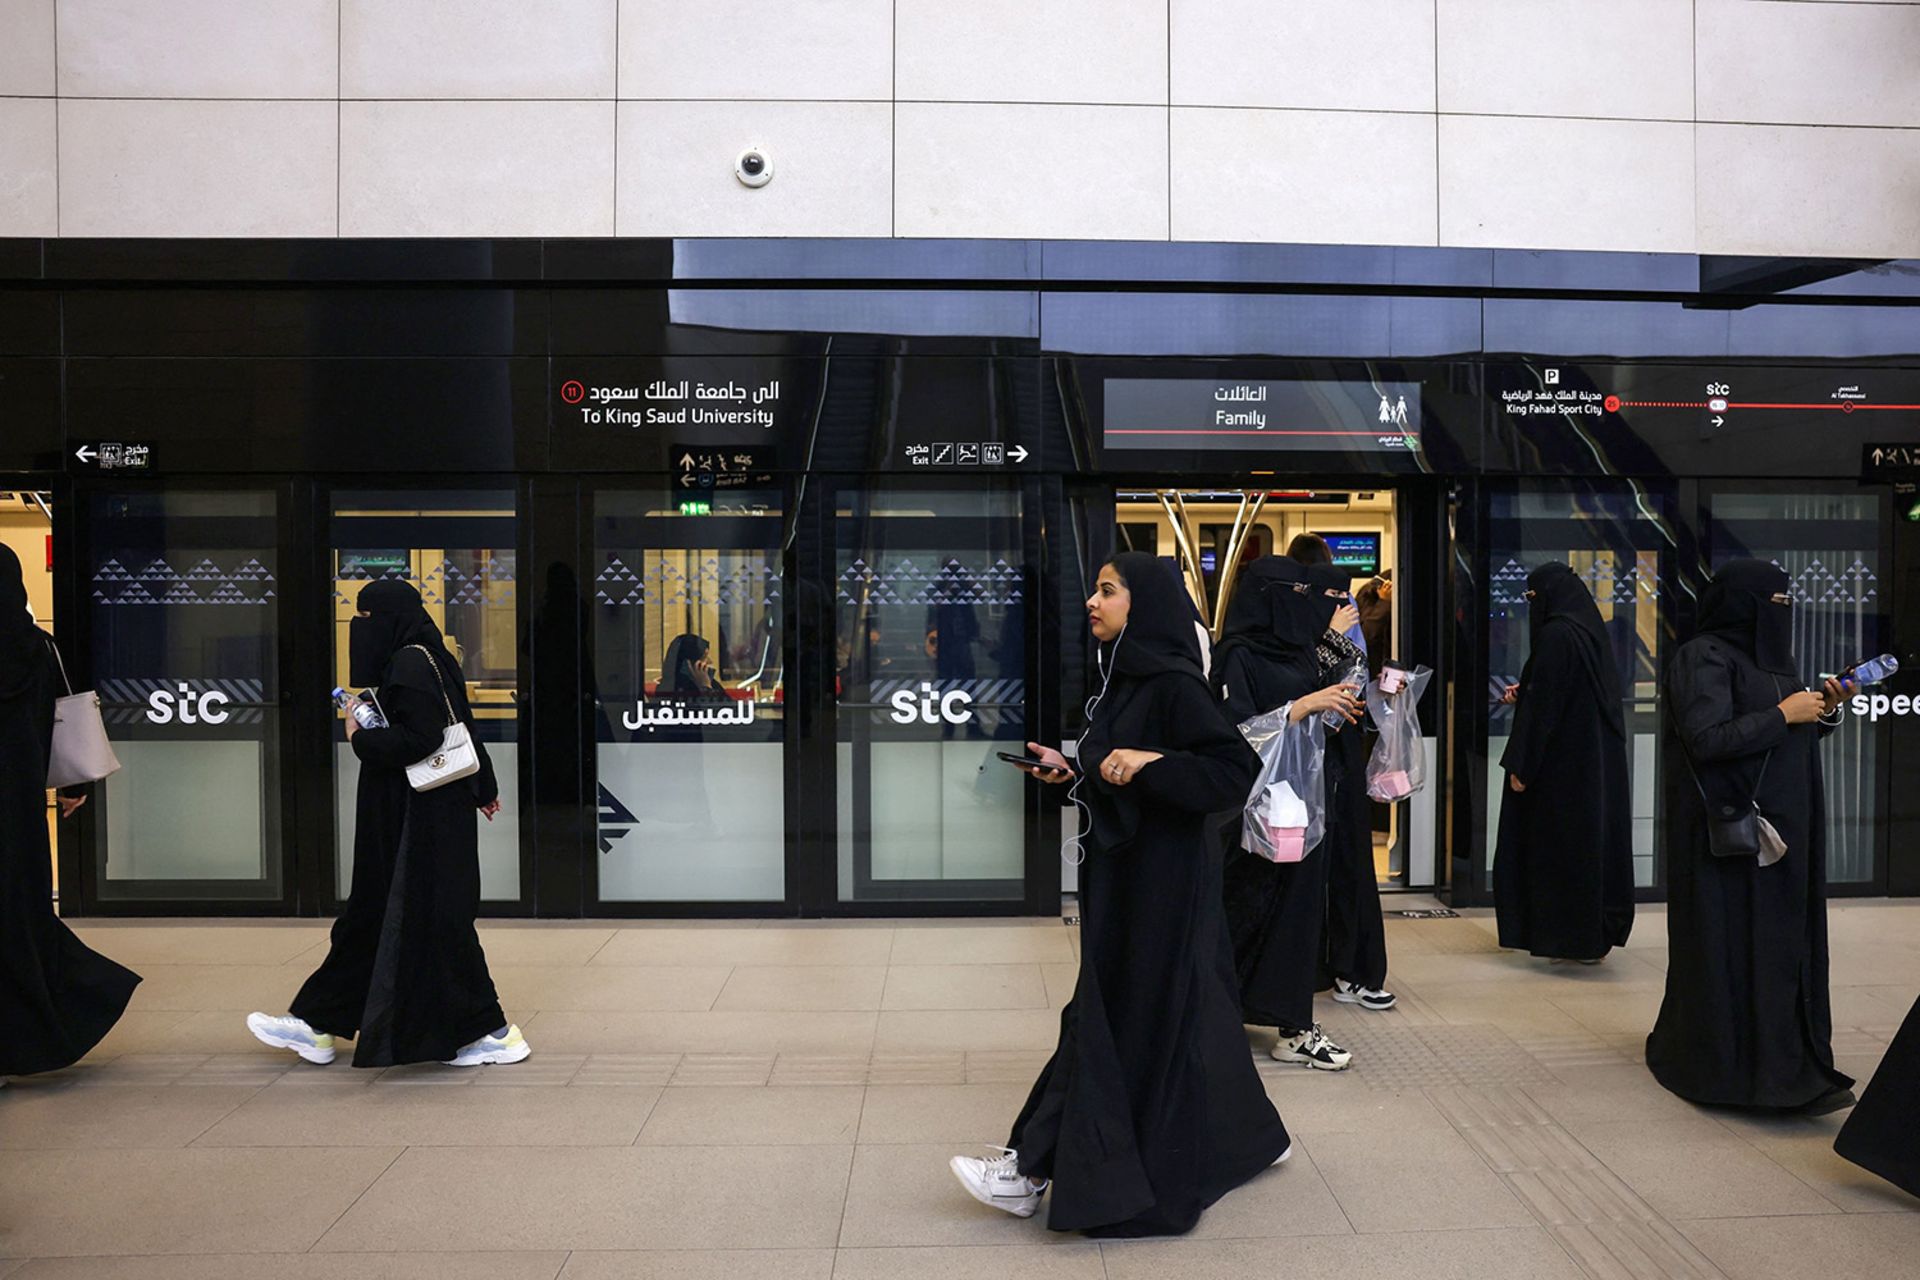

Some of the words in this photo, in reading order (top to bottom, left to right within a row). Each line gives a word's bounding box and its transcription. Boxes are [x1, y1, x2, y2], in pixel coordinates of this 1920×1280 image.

[568, 388, 577, 396] 11
[590, 387, 638, 404] سعود
[645, 381, 689, 399] الملك
[696, 381, 746, 404] جامعة
[1214, 385, 1267, 402] العائلات
[1555, 390, 1577, 400] الملك
[1706, 382, 1730, 396] stc
[582, 408, 601, 424] To
[606, 408, 641, 427] King
[647, 408, 686, 424] Saud
[692, 408, 773, 427] University
[1506, 404, 1527, 416] King
[1529, 404, 1556, 414] Fahad
[1558, 404, 1582, 416] Sport
[1584, 404, 1602, 416] City
[1216, 410, 1266, 430] Family
[905, 444, 929, 456] مخرج
[912, 456, 929, 465] Exit
[146, 683, 229, 724] stc
[890, 682, 973, 724] stc
[622, 698, 755, 731] للمستقبل
